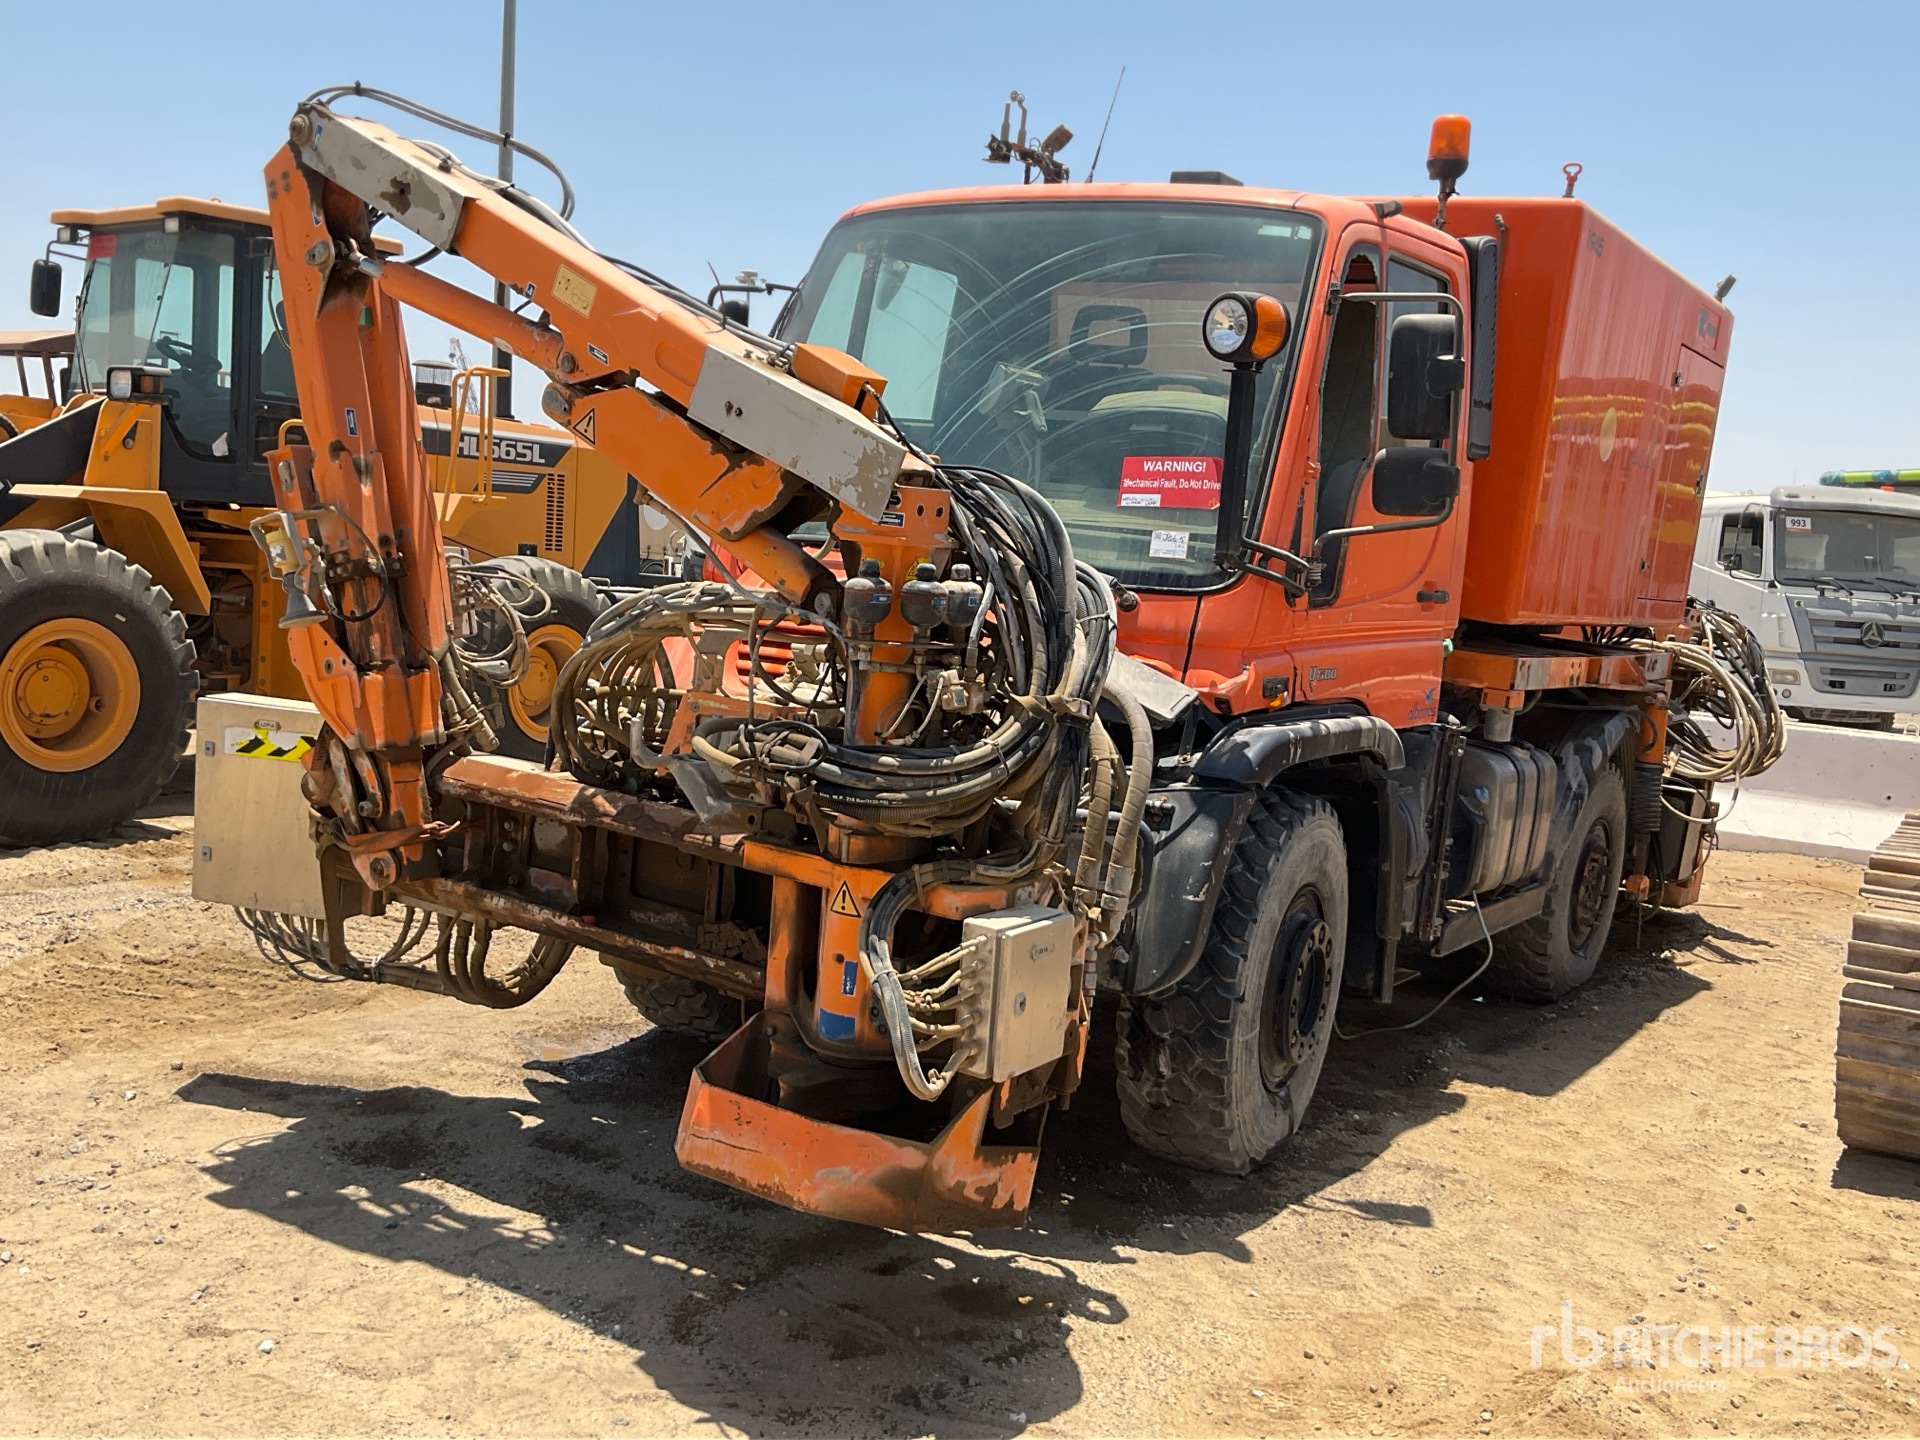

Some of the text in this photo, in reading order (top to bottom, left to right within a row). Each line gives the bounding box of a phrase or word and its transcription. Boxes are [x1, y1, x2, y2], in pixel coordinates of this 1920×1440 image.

[1143, 461, 1206, 472] WARNING!
[1123, 478, 1159, 488] Mechanical
[1160, 479, 1178, 489] Fault,
[1179, 479, 1189, 488] Do
[1203, 480, 1221, 490] Drive
[1790, 519, 1807, 528] 993
